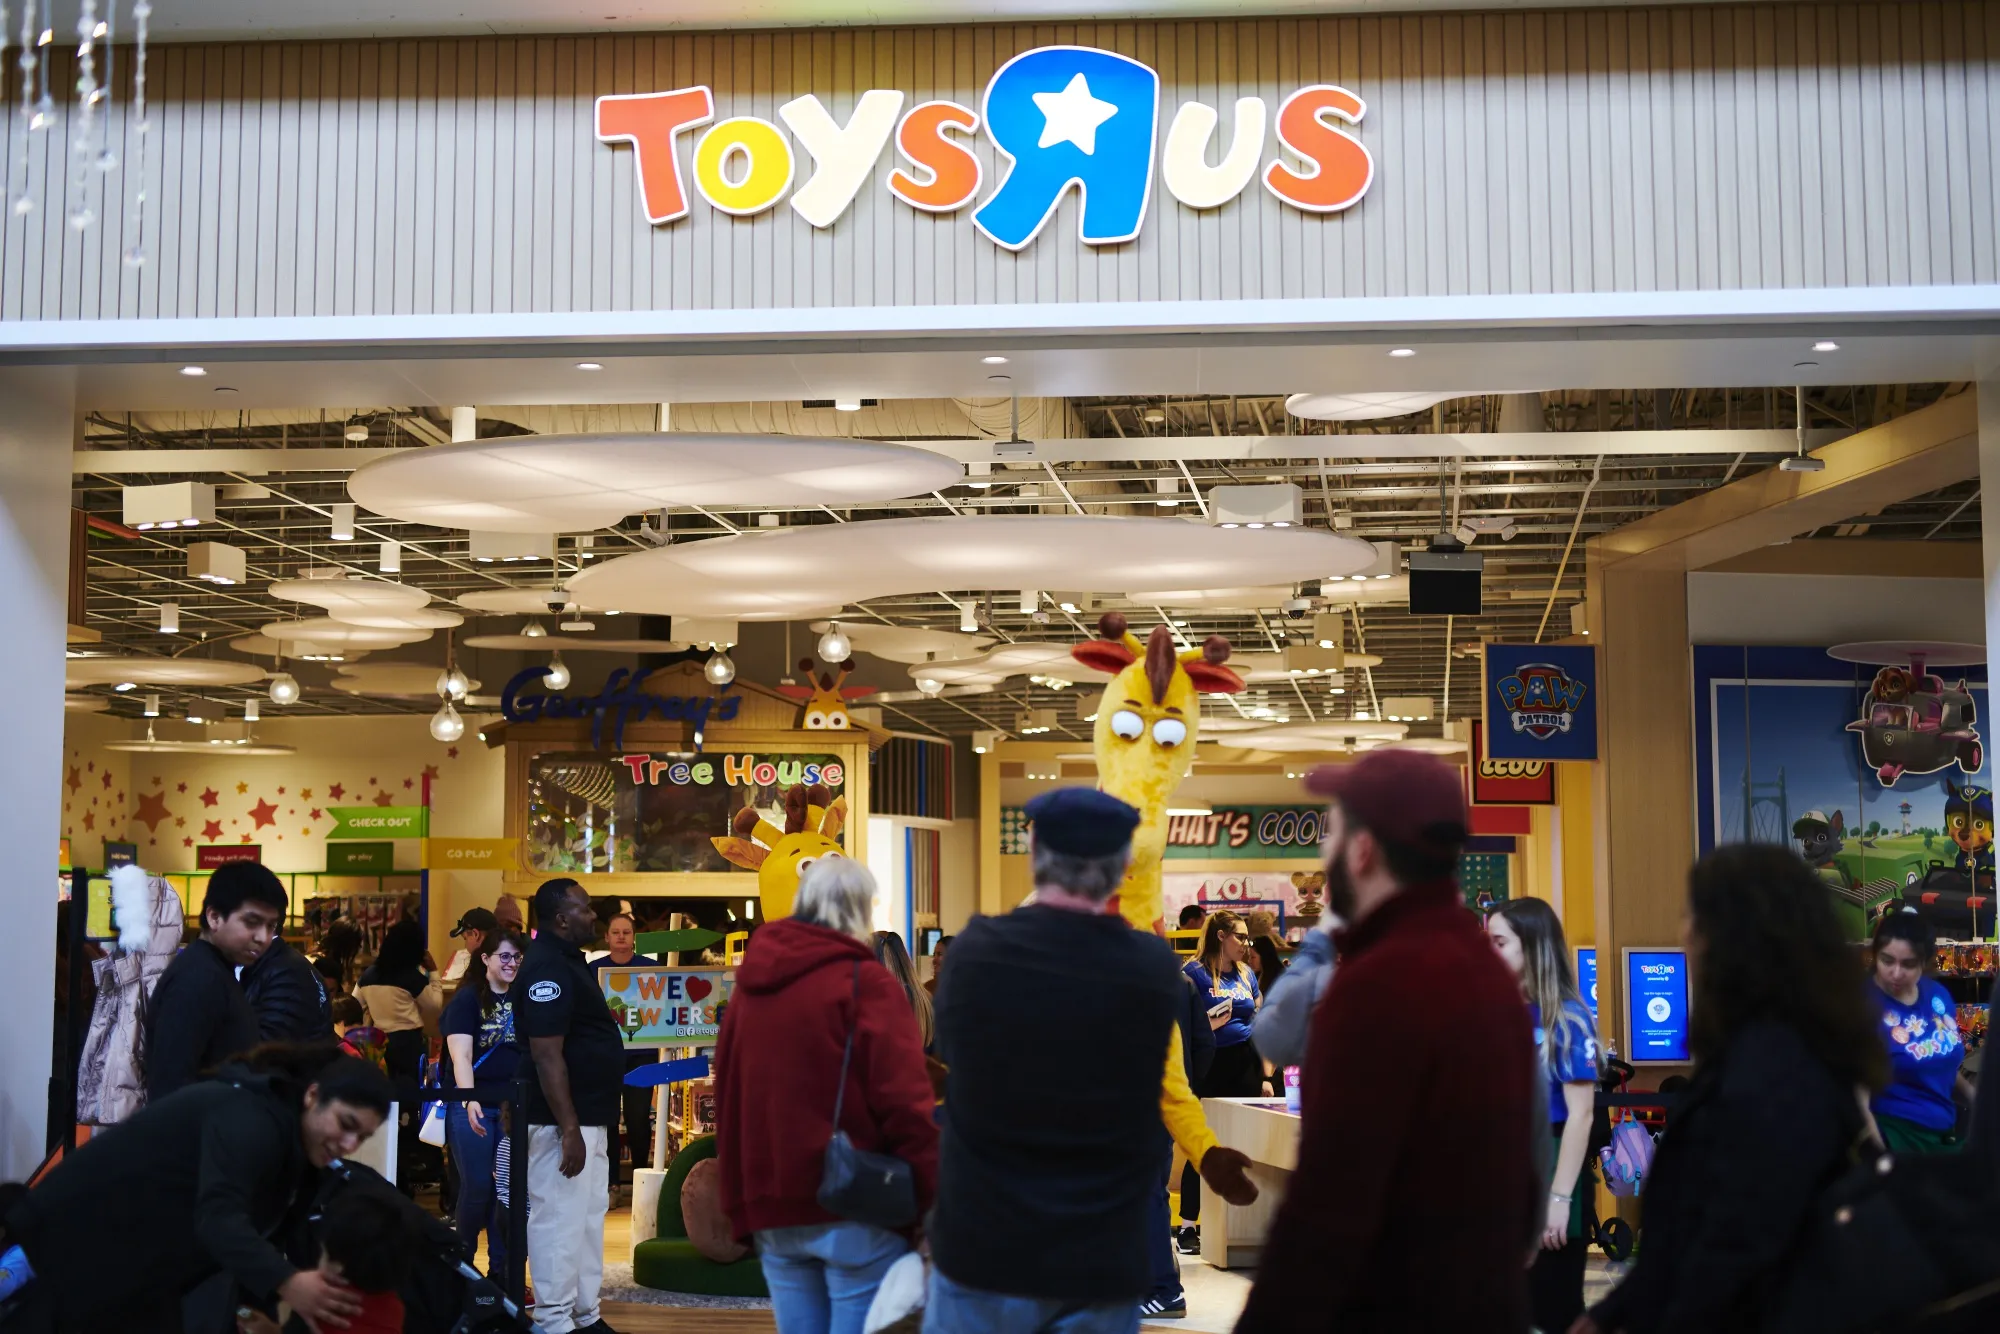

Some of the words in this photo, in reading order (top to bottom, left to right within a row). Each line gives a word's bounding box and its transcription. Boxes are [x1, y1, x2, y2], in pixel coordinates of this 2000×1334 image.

[1496, 675, 1587, 711] PAW
[501, 667, 742, 750] Geoffrey's
[1518, 714, 1565, 726] PATROL
[623, 754, 714, 785] Tree
[724, 755, 844, 786] House
[349, 817, 386, 828] CHECK
[387, 817, 411, 828] OUT
[1167, 811, 1251, 847] HAT'S
[447, 849, 463, 859] GO
[465, 849, 492, 859] PLAY
[637, 976, 682, 1000] WE
[610, 1008, 662, 1027] NEW
[665, 1005, 726, 1026] JERSE
